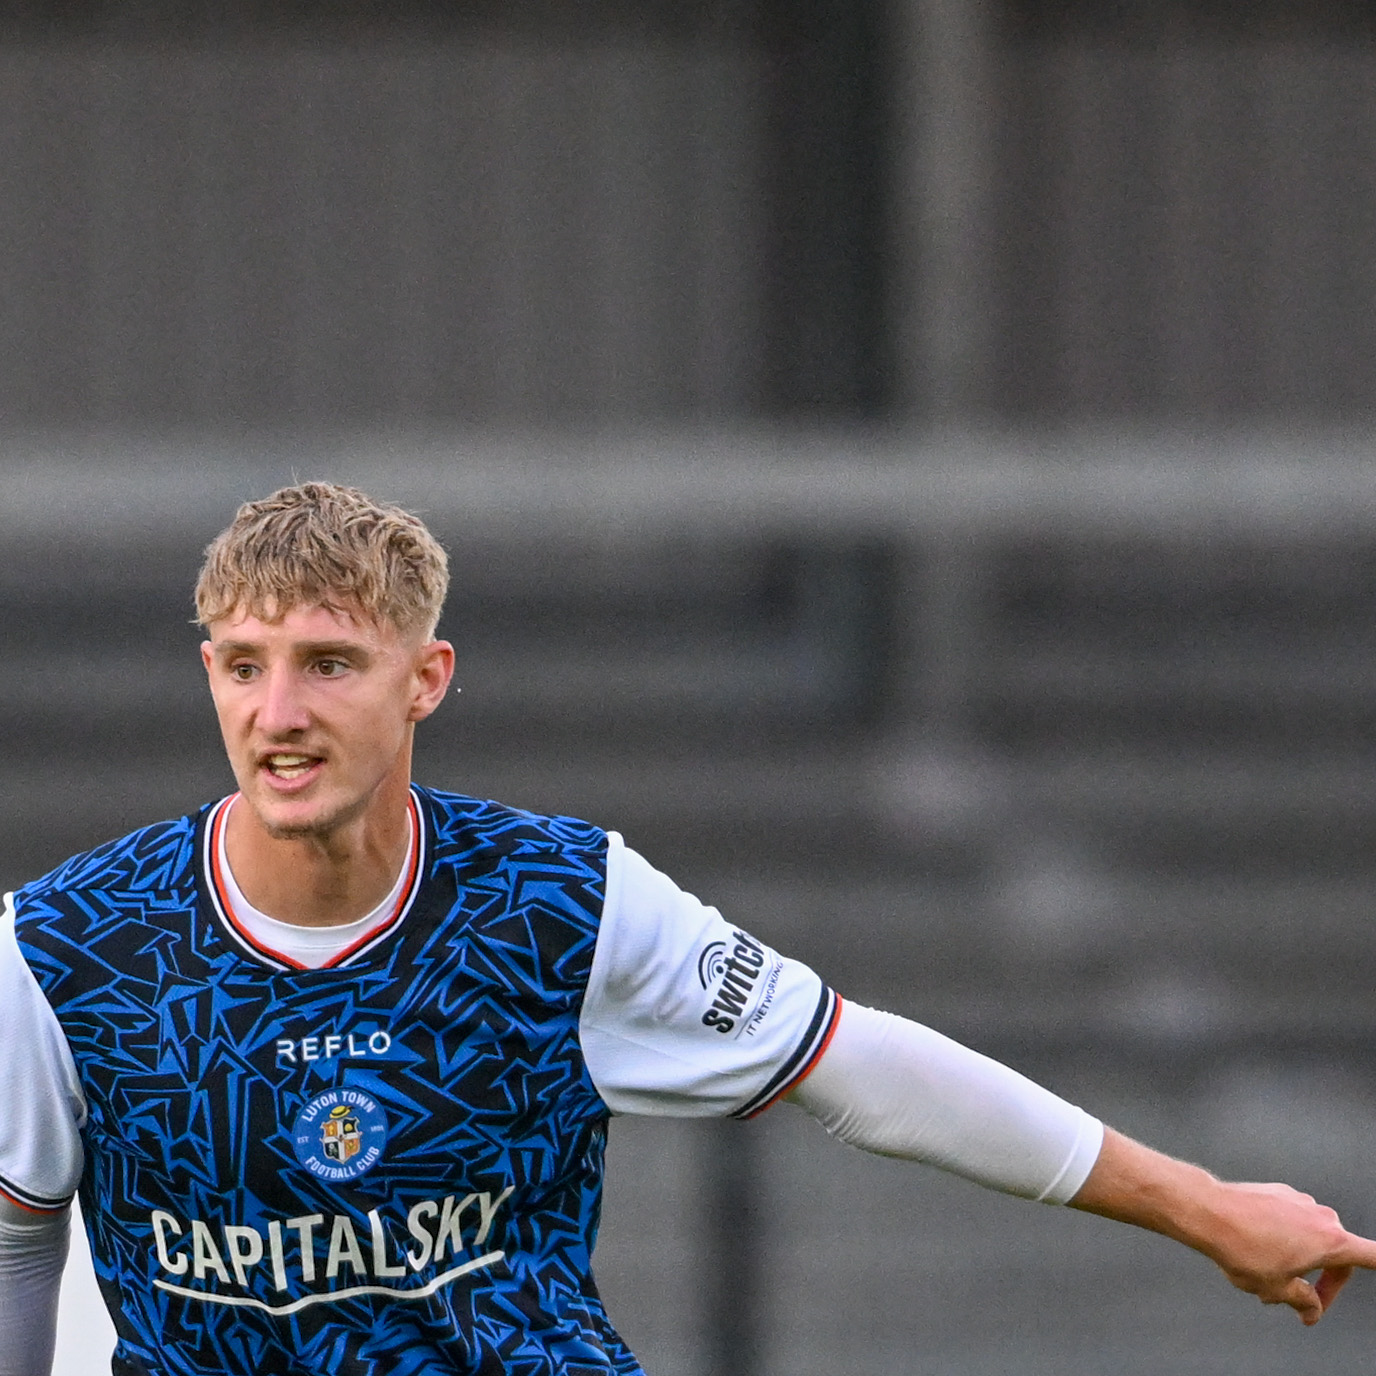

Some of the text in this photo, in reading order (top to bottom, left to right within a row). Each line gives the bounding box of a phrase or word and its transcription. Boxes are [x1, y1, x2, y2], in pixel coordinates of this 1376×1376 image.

[746, 961, 784, 1037] IT NETWORKING
[277, 1031, 392, 1064] REFLO
[301, 1091, 376, 1123] LUTON TOWN
[305, 1146, 380, 1179] FOOTBALL CLUB
[151, 1185, 515, 1293] CAPITALSKY
